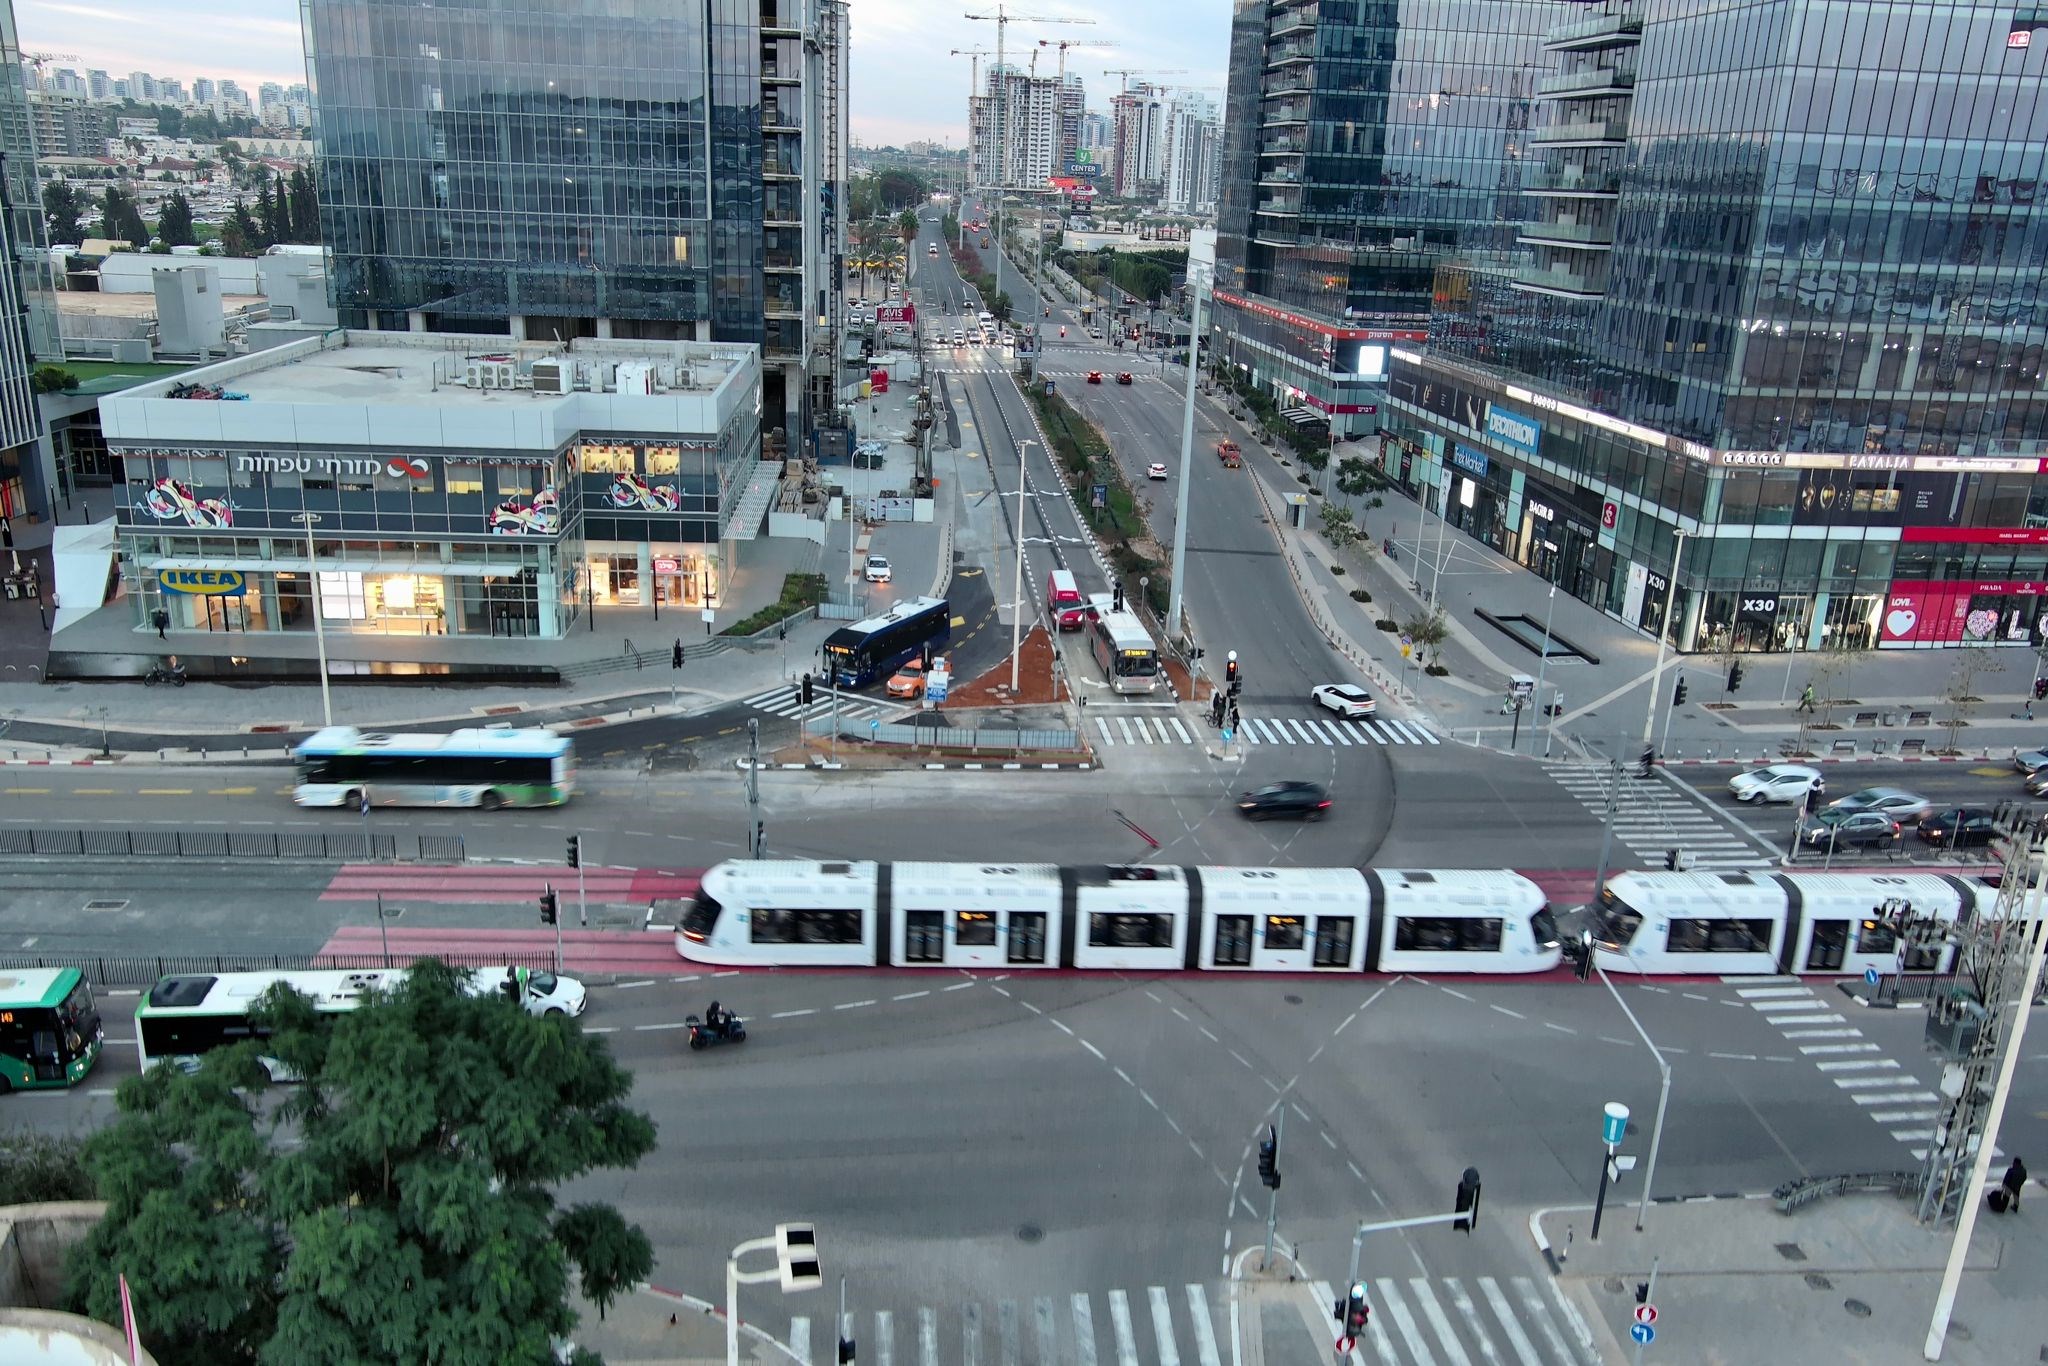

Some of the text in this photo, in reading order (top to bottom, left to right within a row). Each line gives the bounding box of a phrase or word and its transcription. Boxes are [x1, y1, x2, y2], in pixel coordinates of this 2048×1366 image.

[1071, 164, 1095, 172] CENTER
[883, 308, 903, 317] AVIS
[1368, 331, 1393, 340] הסטוק
[1489, 412, 1536, 447] DECATHLON
[236, 455, 382, 475] מזרחי טפחות
[1850, 455, 1909, 469] EATALIA
[1529, 499, 1548, 519] BAGIR
[167, 571, 236, 586] IKEA
[1648, 573, 1665, 591] X30
[1742, 599, 1775, 612] X30
[1891, 597, 1911, 607] LOVE
